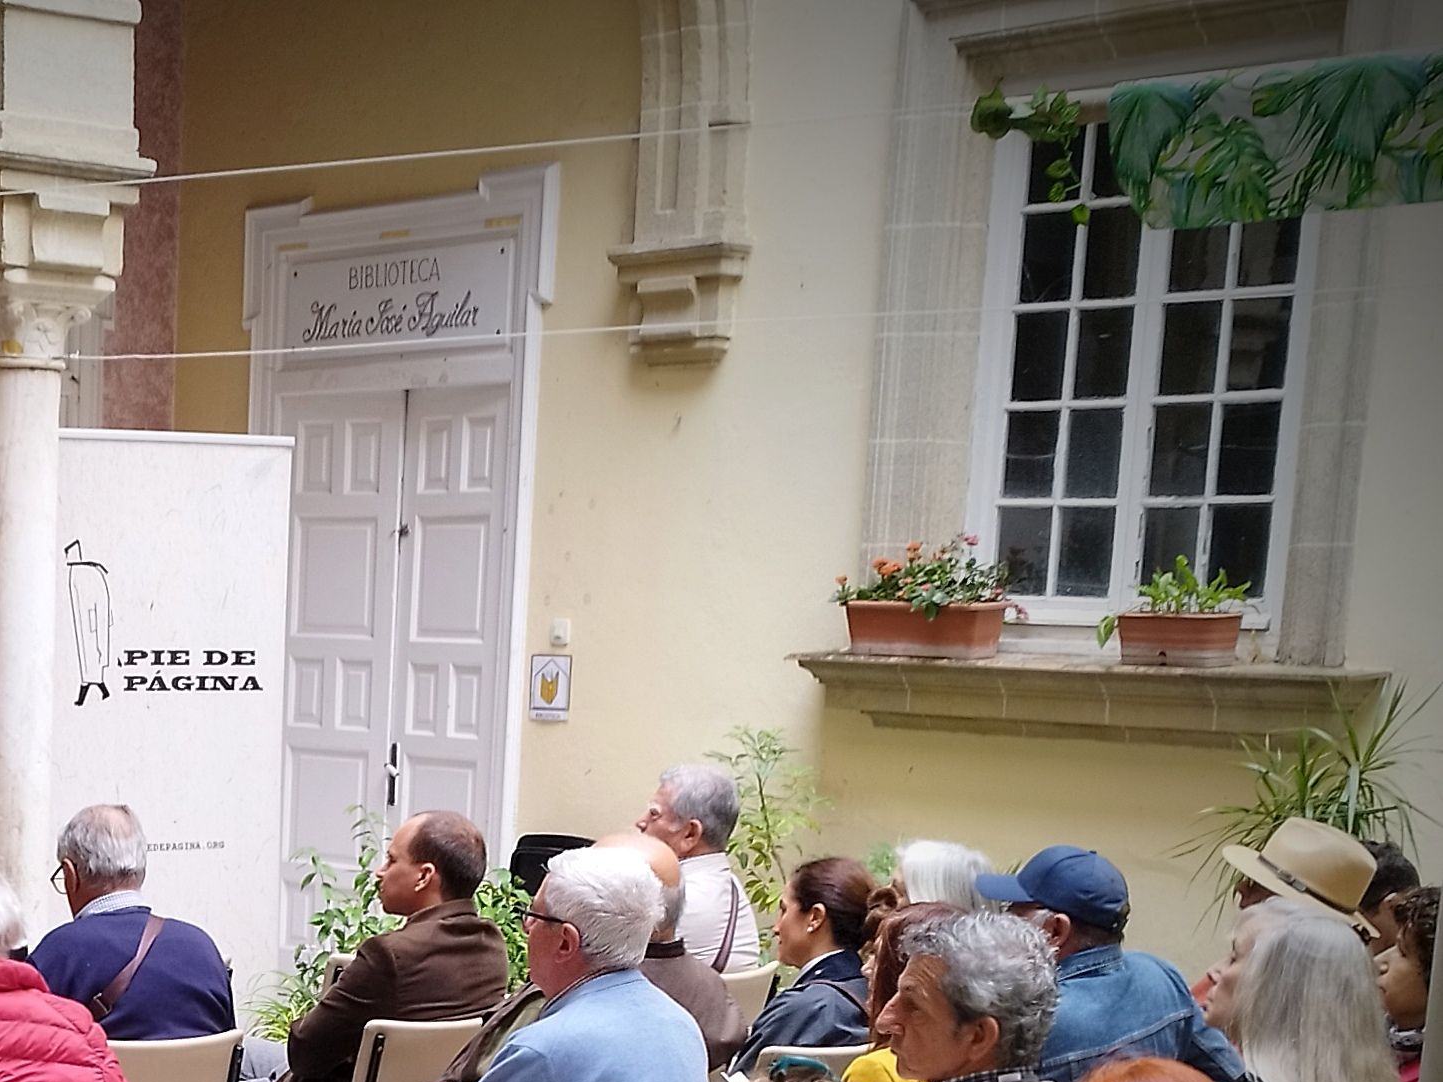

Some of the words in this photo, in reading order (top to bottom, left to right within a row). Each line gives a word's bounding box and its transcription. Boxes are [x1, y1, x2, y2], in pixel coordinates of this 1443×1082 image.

[348, 258, 440, 289] BIBLIOTECA
[366, 298, 406, 336] José
[408, 290, 479, 337] Aguilar
[123, 650, 190, 666] PIE
[203, 650, 256, 666] DE
[123, 670, 263, 691] PÁGINA
